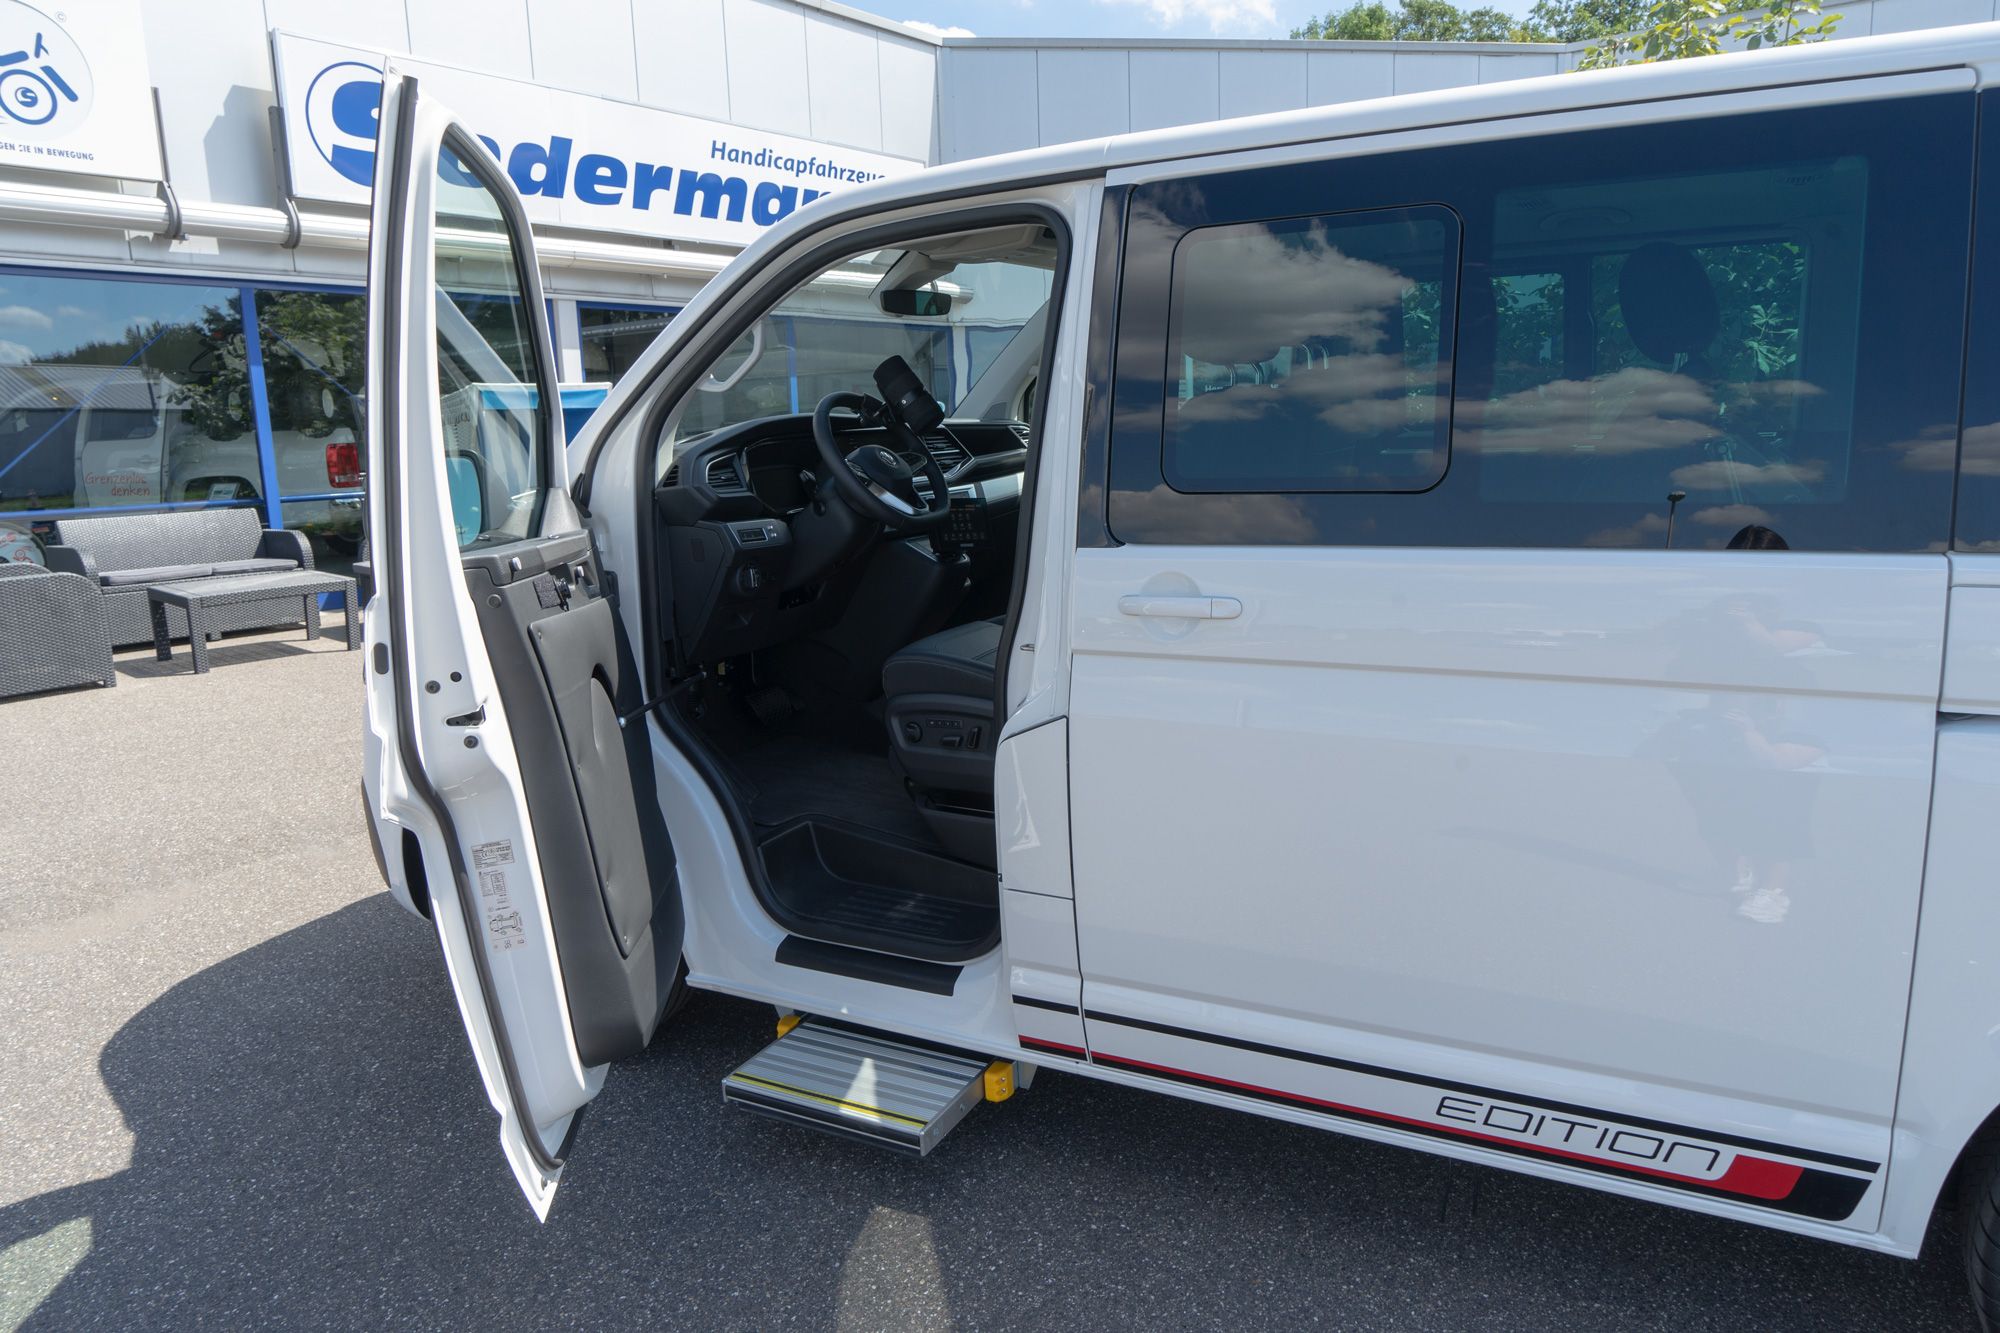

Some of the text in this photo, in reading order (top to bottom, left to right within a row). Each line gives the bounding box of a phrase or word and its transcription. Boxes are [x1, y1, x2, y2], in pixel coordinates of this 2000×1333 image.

[34, 146, 44, 154] IN
[46, 147, 94, 160] BEWEGUNG
[111, 484, 151, 497] denken
[1435, 1095, 1721, 1172] EDITION
